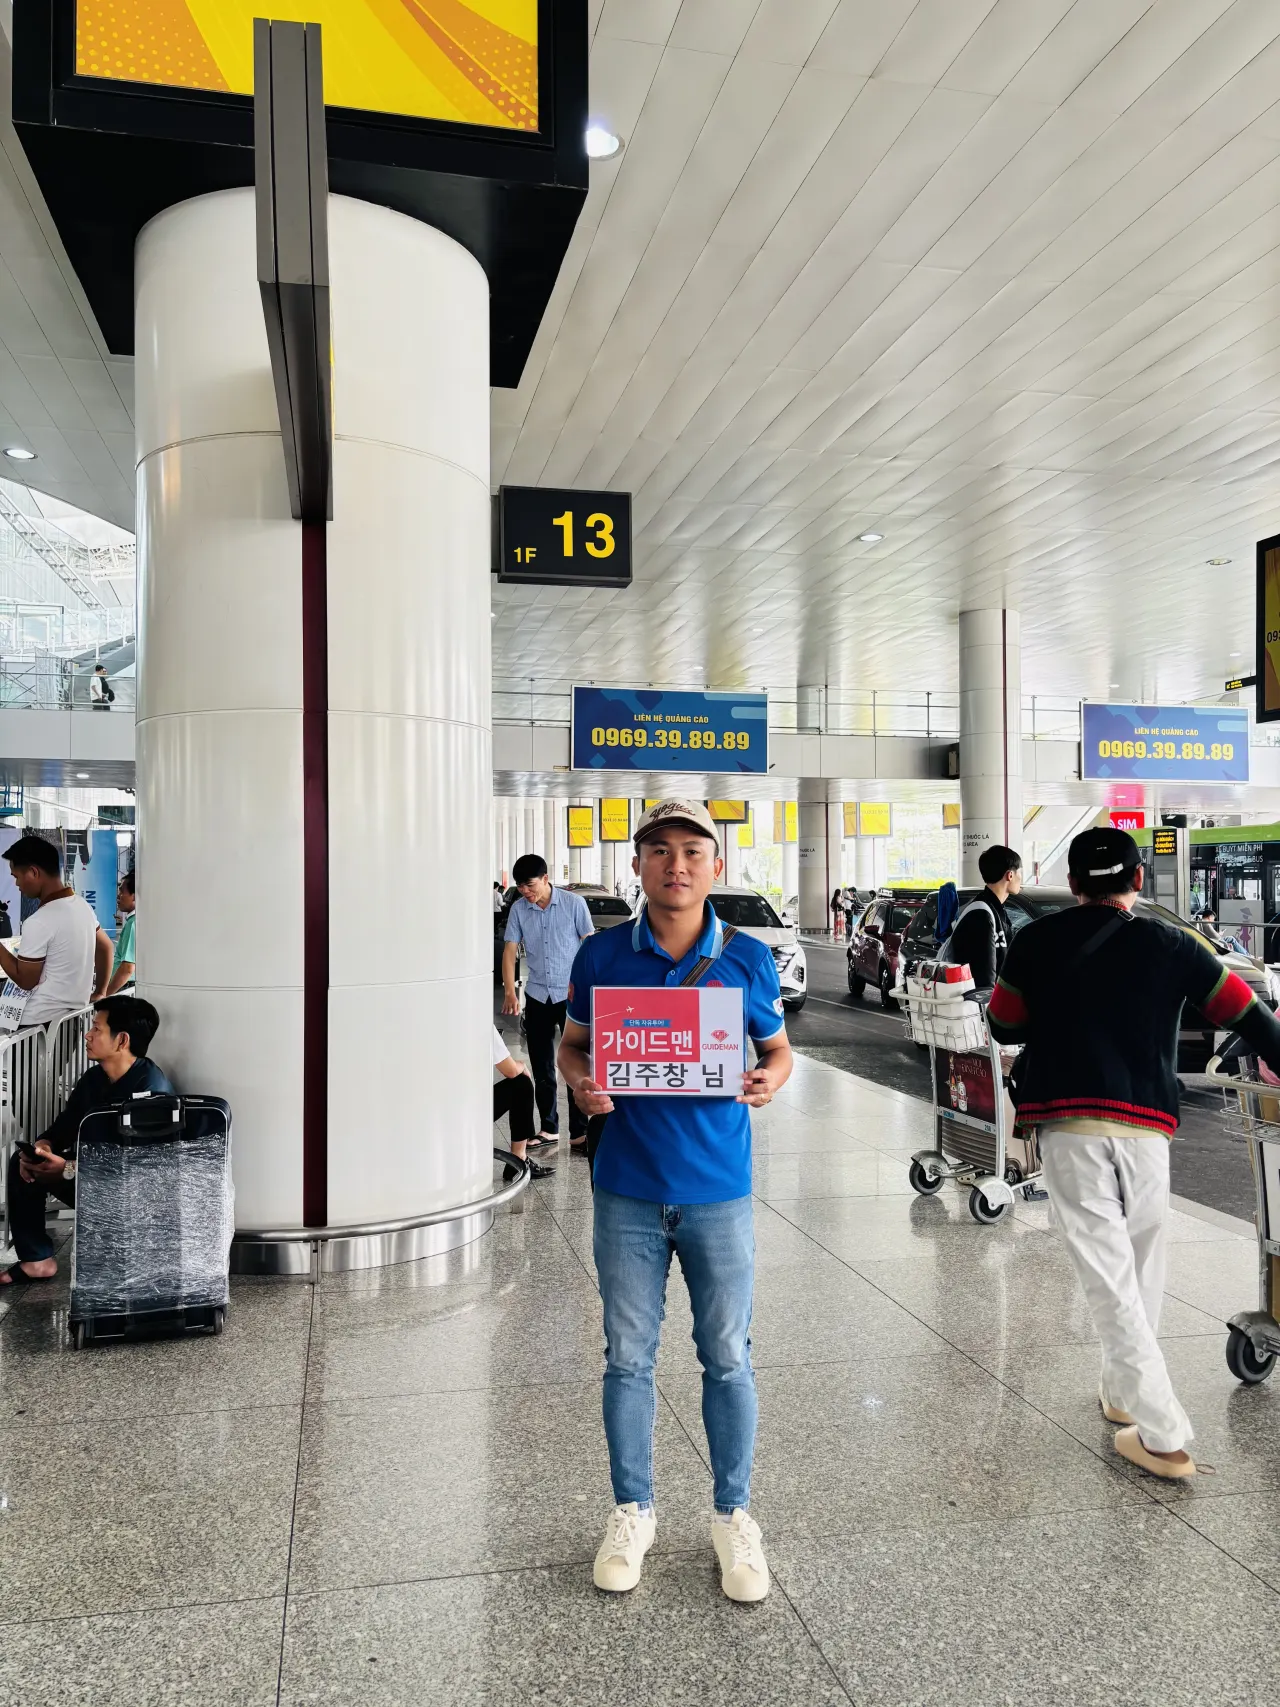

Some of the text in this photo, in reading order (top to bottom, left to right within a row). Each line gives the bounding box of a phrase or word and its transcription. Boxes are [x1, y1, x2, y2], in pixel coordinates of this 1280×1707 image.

[552, 510, 616, 558] 13
[513, 547, 537, 564] 1F
[634, 714, 709, 723] LIÊN HỆ QUẢNG CÁO
[591, 727, 751, 750] 0969.39.89.89
[1134, 727, 1150, 735] LIÊN
[1161, 727, 1184, 736] QUẢNG
[1185, 728, 1199, 736] CÁO
[1099, 740, 1234, 760] 0969.39.89.89
[1117, 818, 1138, 829] SIM
[602, 1029, 693, 1056] 가이드맨
[701, 1043, 739, 1051] GUIDEMAN
[608, 1062, 724, 1088] 김주창 님
